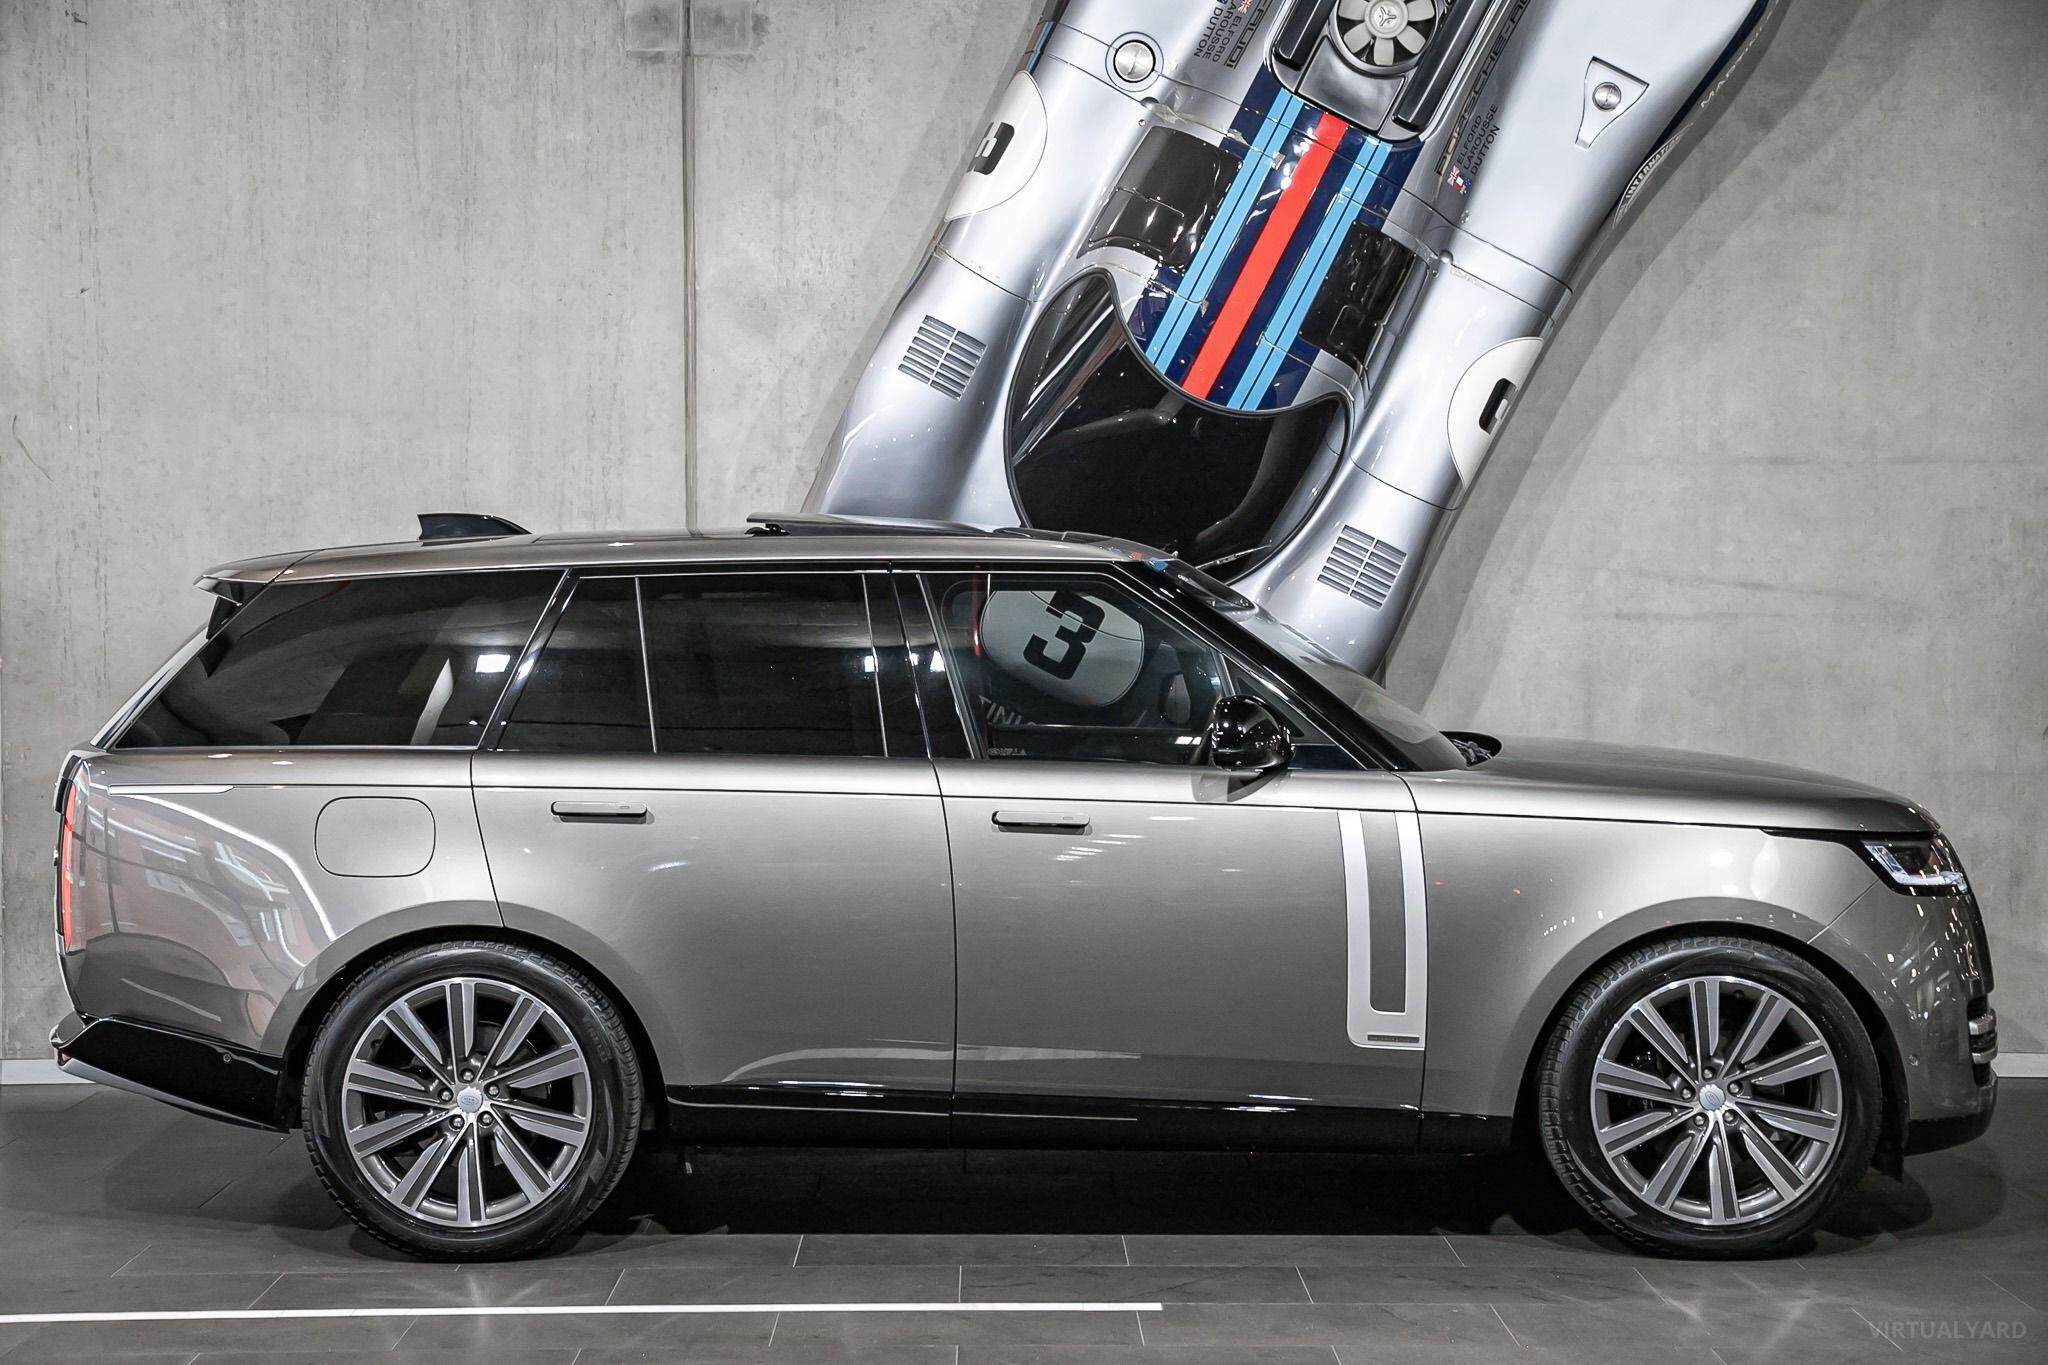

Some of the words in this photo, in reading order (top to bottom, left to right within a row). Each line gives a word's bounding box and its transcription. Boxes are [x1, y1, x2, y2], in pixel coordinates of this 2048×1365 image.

[1193, 6, 1224, 57] DUTTON
[1202, 0, 1236, 60] AROUSSE
[1213, 15, 1242, 63] ELFORD
[1435, 0, 1528, 175] PORSCHE-A
[1457, 114, 1483, 165] ELFORD
[1464, 103, 1499, 170] LAROUSSE
[1470, 124, 1501, 175] DUTTON
[1023, 590, 1106, 681] 3
